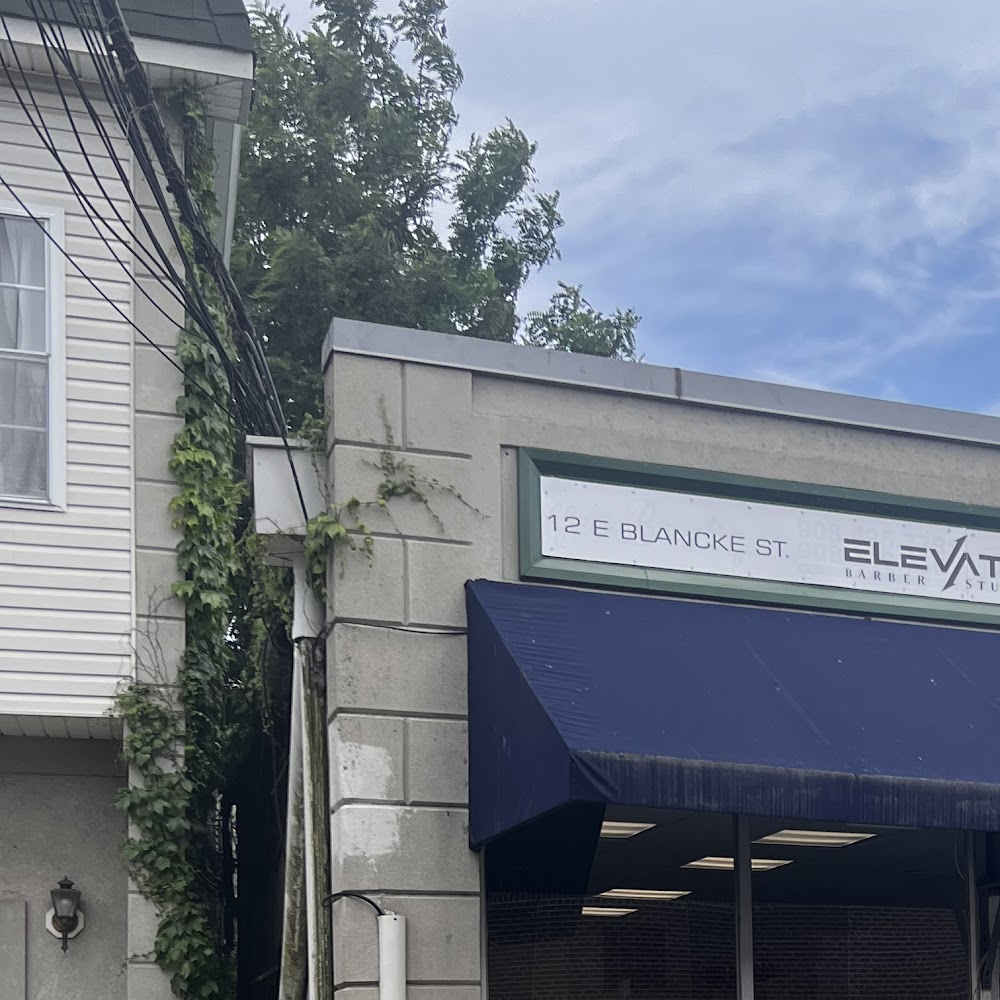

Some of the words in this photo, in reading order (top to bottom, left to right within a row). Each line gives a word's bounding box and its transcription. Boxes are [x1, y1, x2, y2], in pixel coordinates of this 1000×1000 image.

[547, 514, 581, 535] 12
[593, 519, 610, 538] E
[620, 522, 746, 554] BLANCKE
[755, 538, 790, 559] ST.
[845, 568, 926, 586] BARBER
